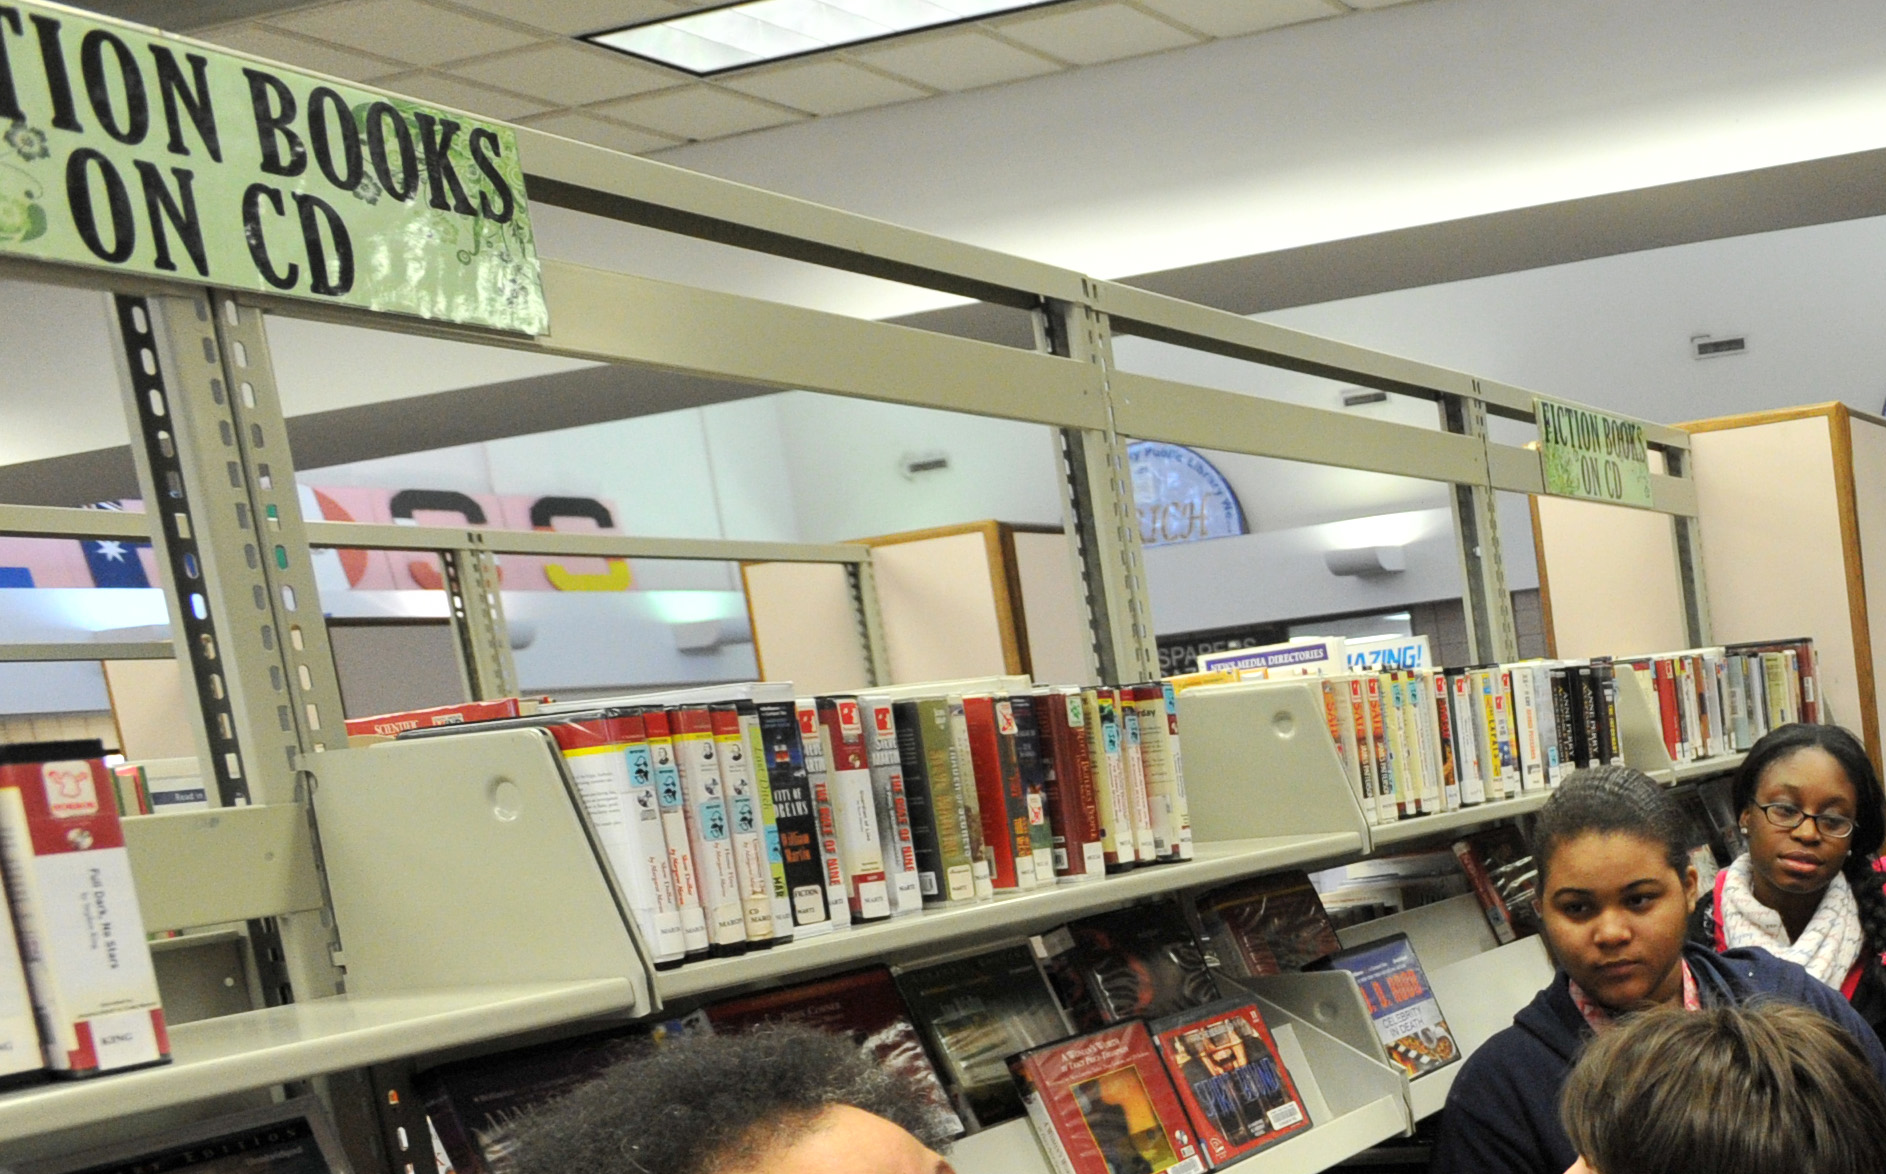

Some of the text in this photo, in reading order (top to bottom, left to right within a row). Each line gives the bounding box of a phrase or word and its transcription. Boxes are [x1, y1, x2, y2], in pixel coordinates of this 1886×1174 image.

[242, 67, 515, 223] BOOKS
[66, 147, 355, 296] ON CD
[1541, 401, 1647, 463] FICTION BOOKS
[1581, 455, 1622, 499] ON CD
[1236, 657, 1267, 670] MEDIA
[1268, 648, 1325, 667] DIRECTORIES
[1347, 644, 1422, 668] AZING!
[823, 857, 843, 887] NINE
[897, 844, 916, 873] NINE
